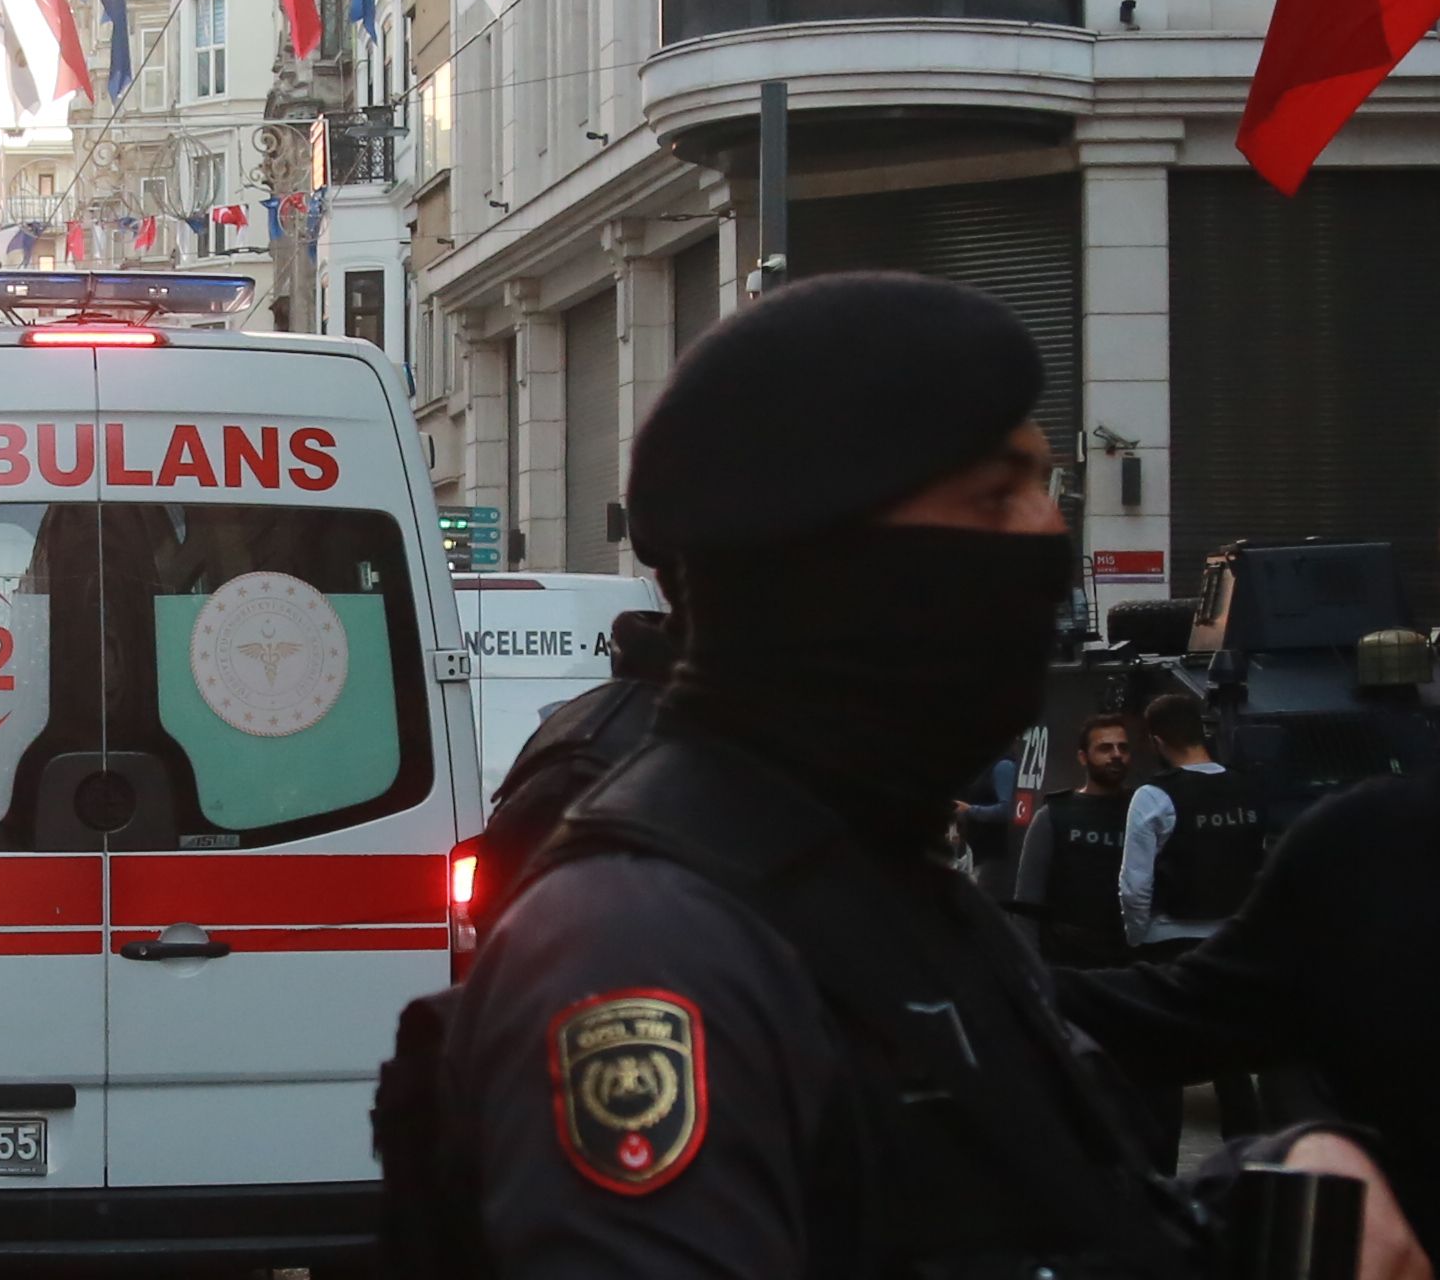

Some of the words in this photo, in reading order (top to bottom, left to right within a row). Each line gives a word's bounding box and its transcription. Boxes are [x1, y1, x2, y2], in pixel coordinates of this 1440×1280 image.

[464, 630, 573, 657] NCELEME
[1196, 807, 1258, 829] POLİS
[1069, 829, 1123, 846] POL
